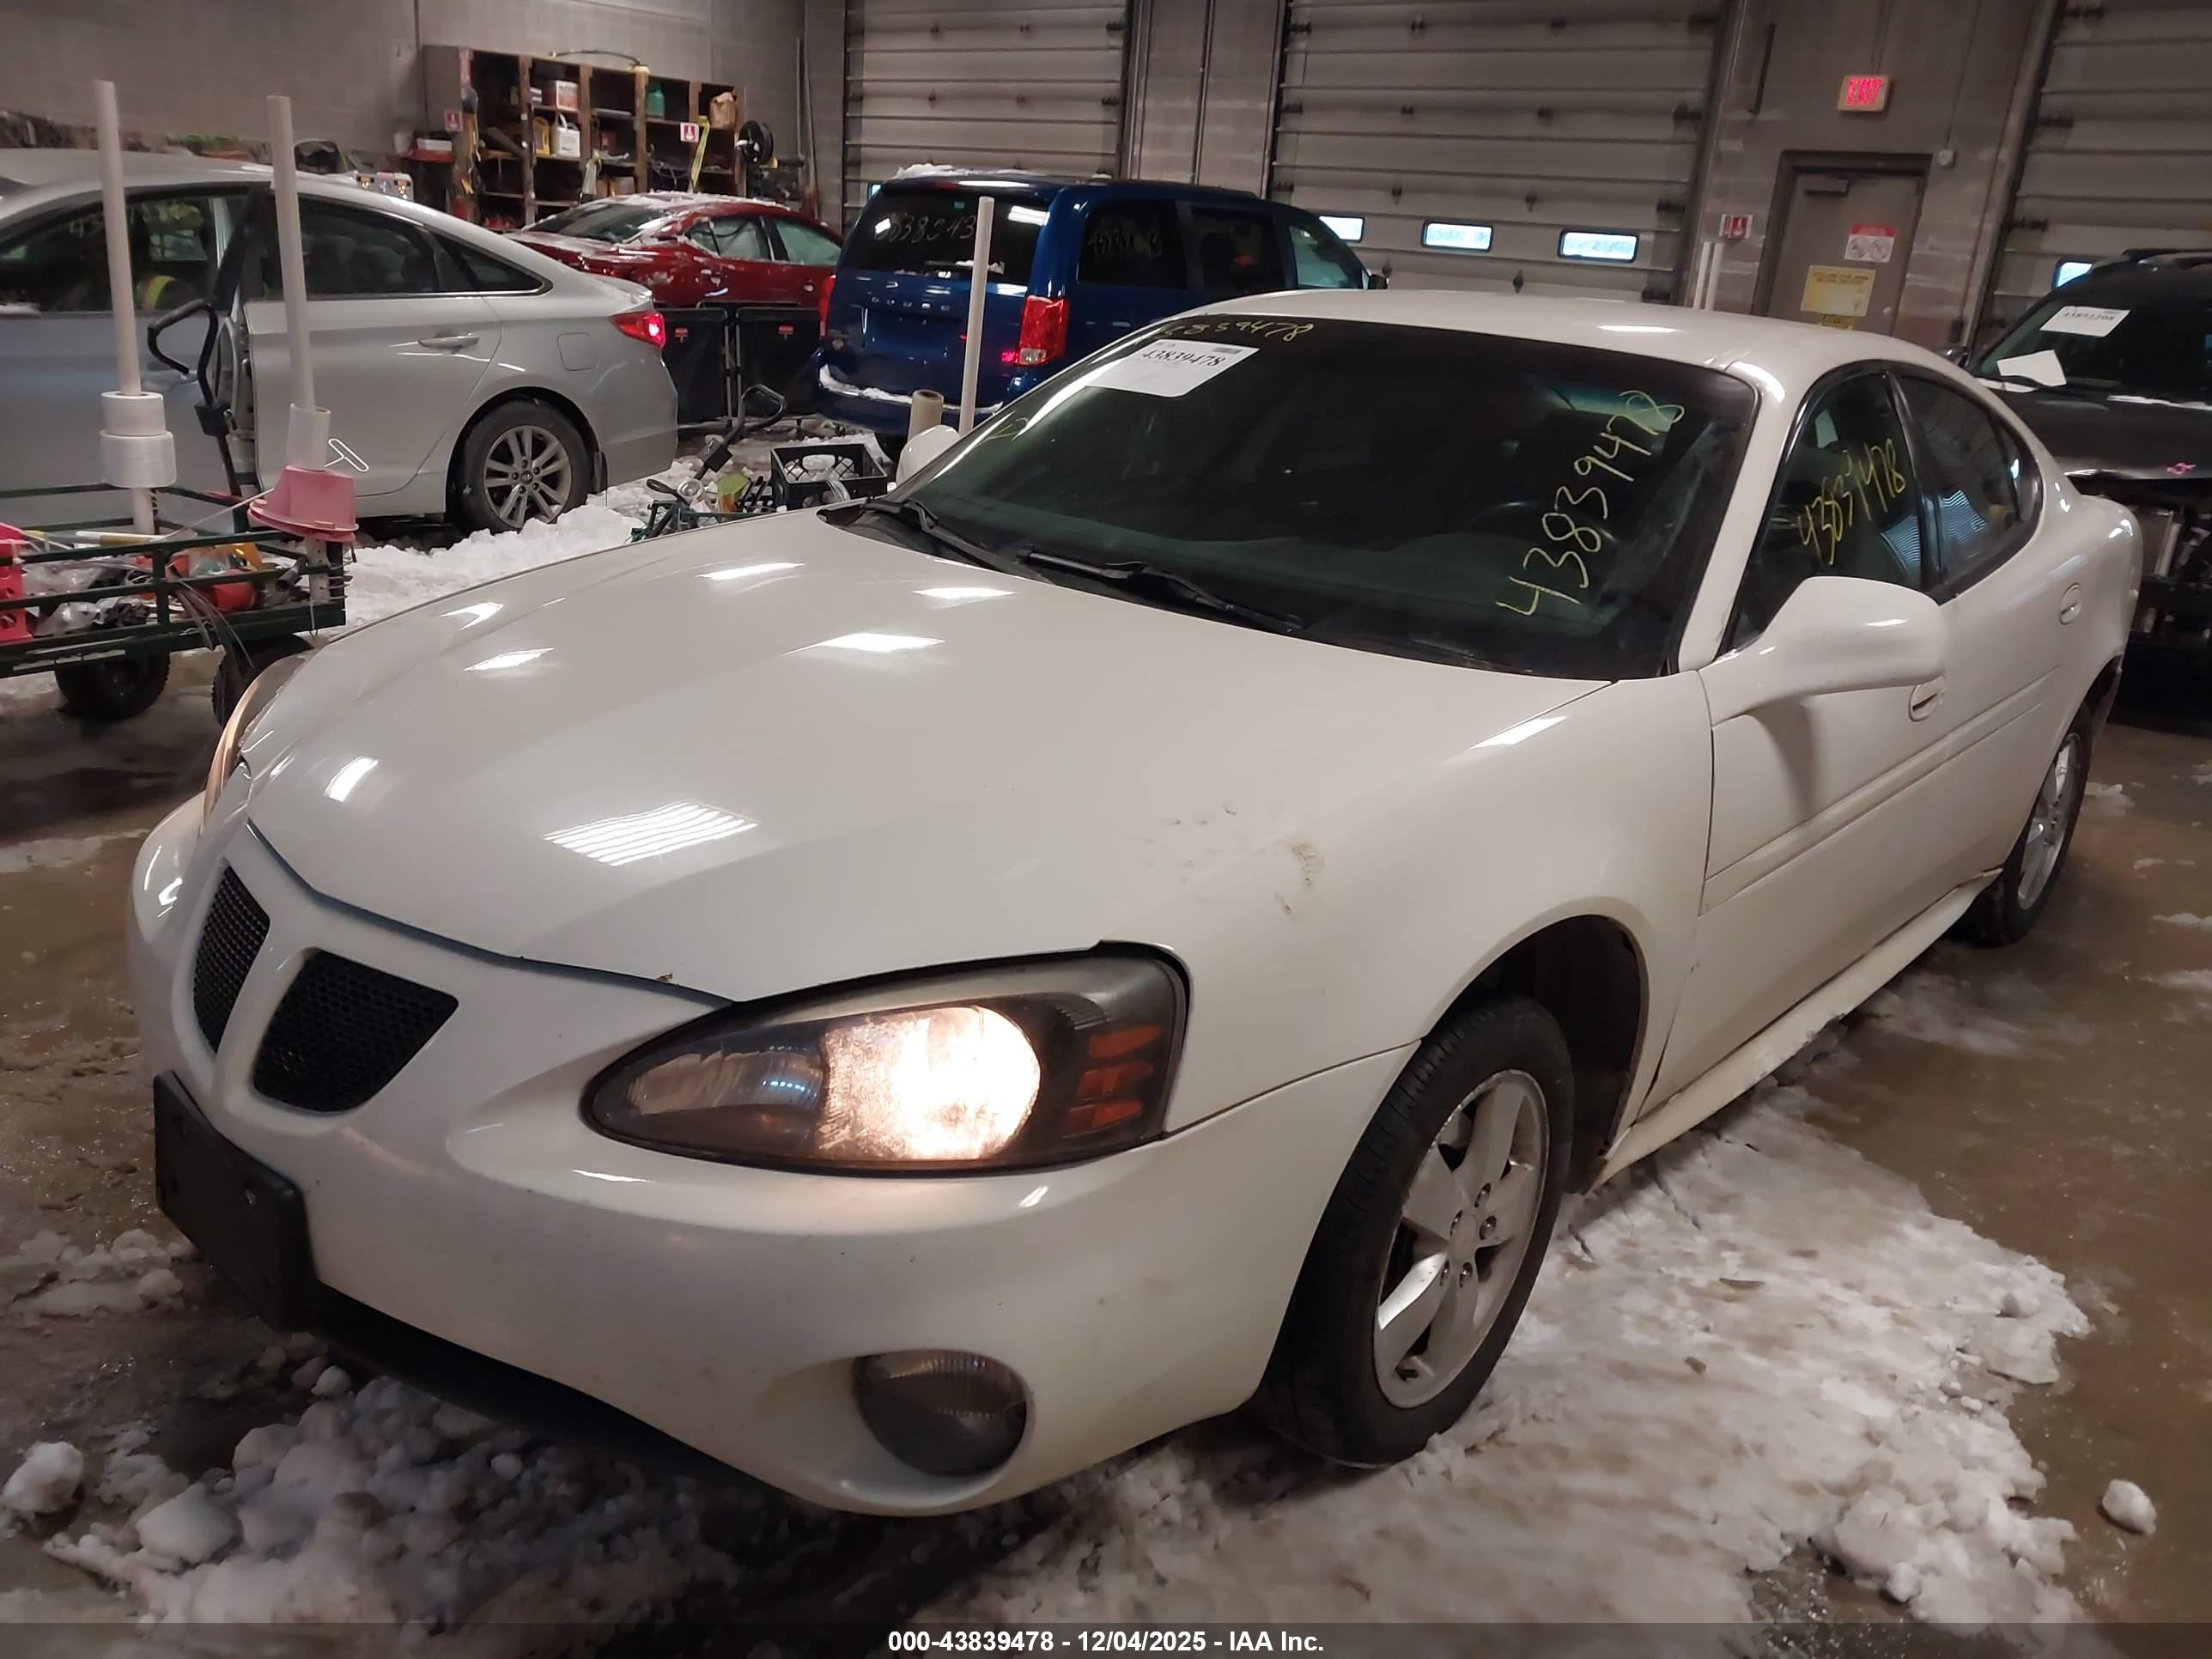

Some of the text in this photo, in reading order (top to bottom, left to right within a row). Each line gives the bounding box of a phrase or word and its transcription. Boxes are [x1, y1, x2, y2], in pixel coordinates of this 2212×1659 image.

[1846, 77, 1883, 105] EXIT
[1142, 345, 1227, 368] 43839478
[1496, 390, 1685, 616] 43839478
